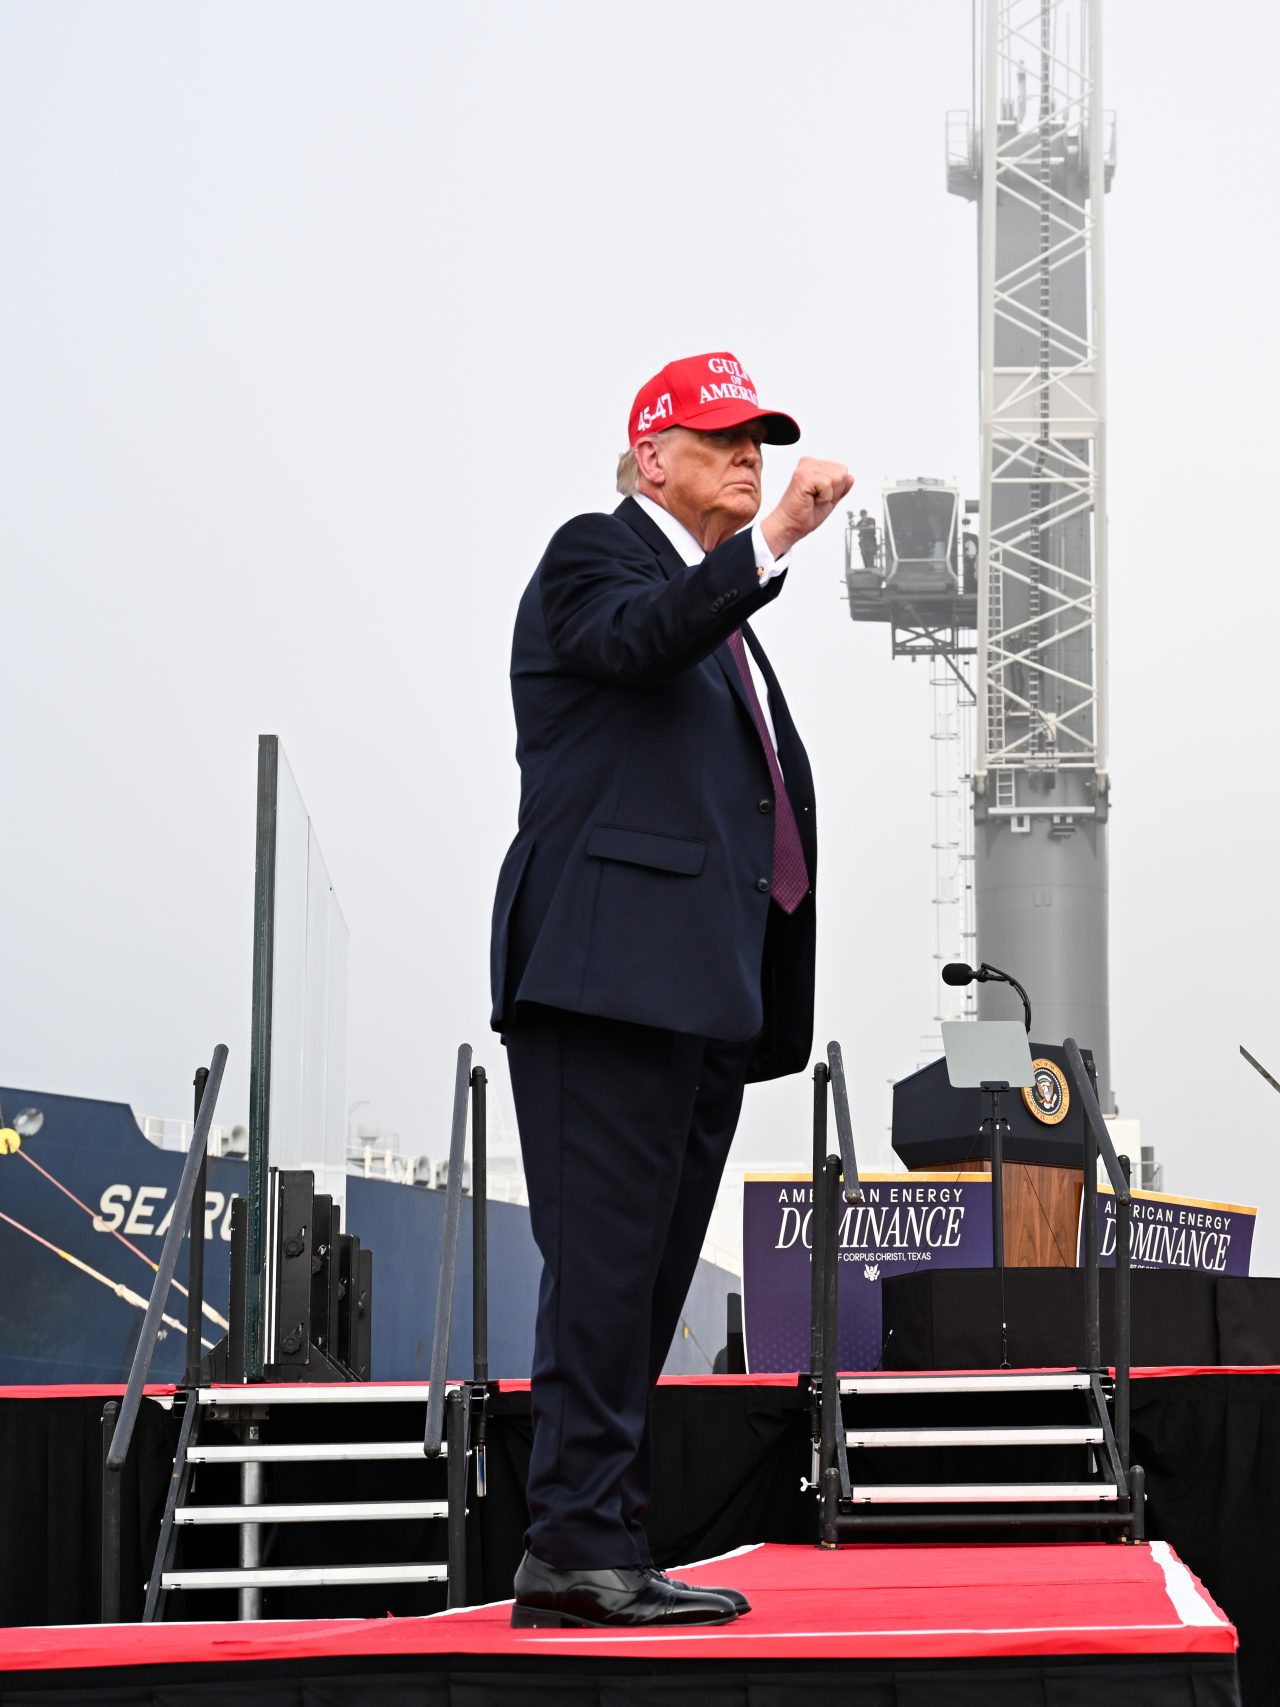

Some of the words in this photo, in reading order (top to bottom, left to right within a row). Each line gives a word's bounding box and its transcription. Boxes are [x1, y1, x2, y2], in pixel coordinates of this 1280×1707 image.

[637, 393, 673, 432] 45-47
[890, 1188, 963, 1203] ENERGY
[1104, 1200, 1173, 1223] ARICAN
[1179, 1211, 1232, 1231] ENERGY
[843, 1252, 875, 1262] CORPUS
[875, 1252, 906, 1262] CHRISTI,
[907, 1251, 932, 1261] TEXAS
